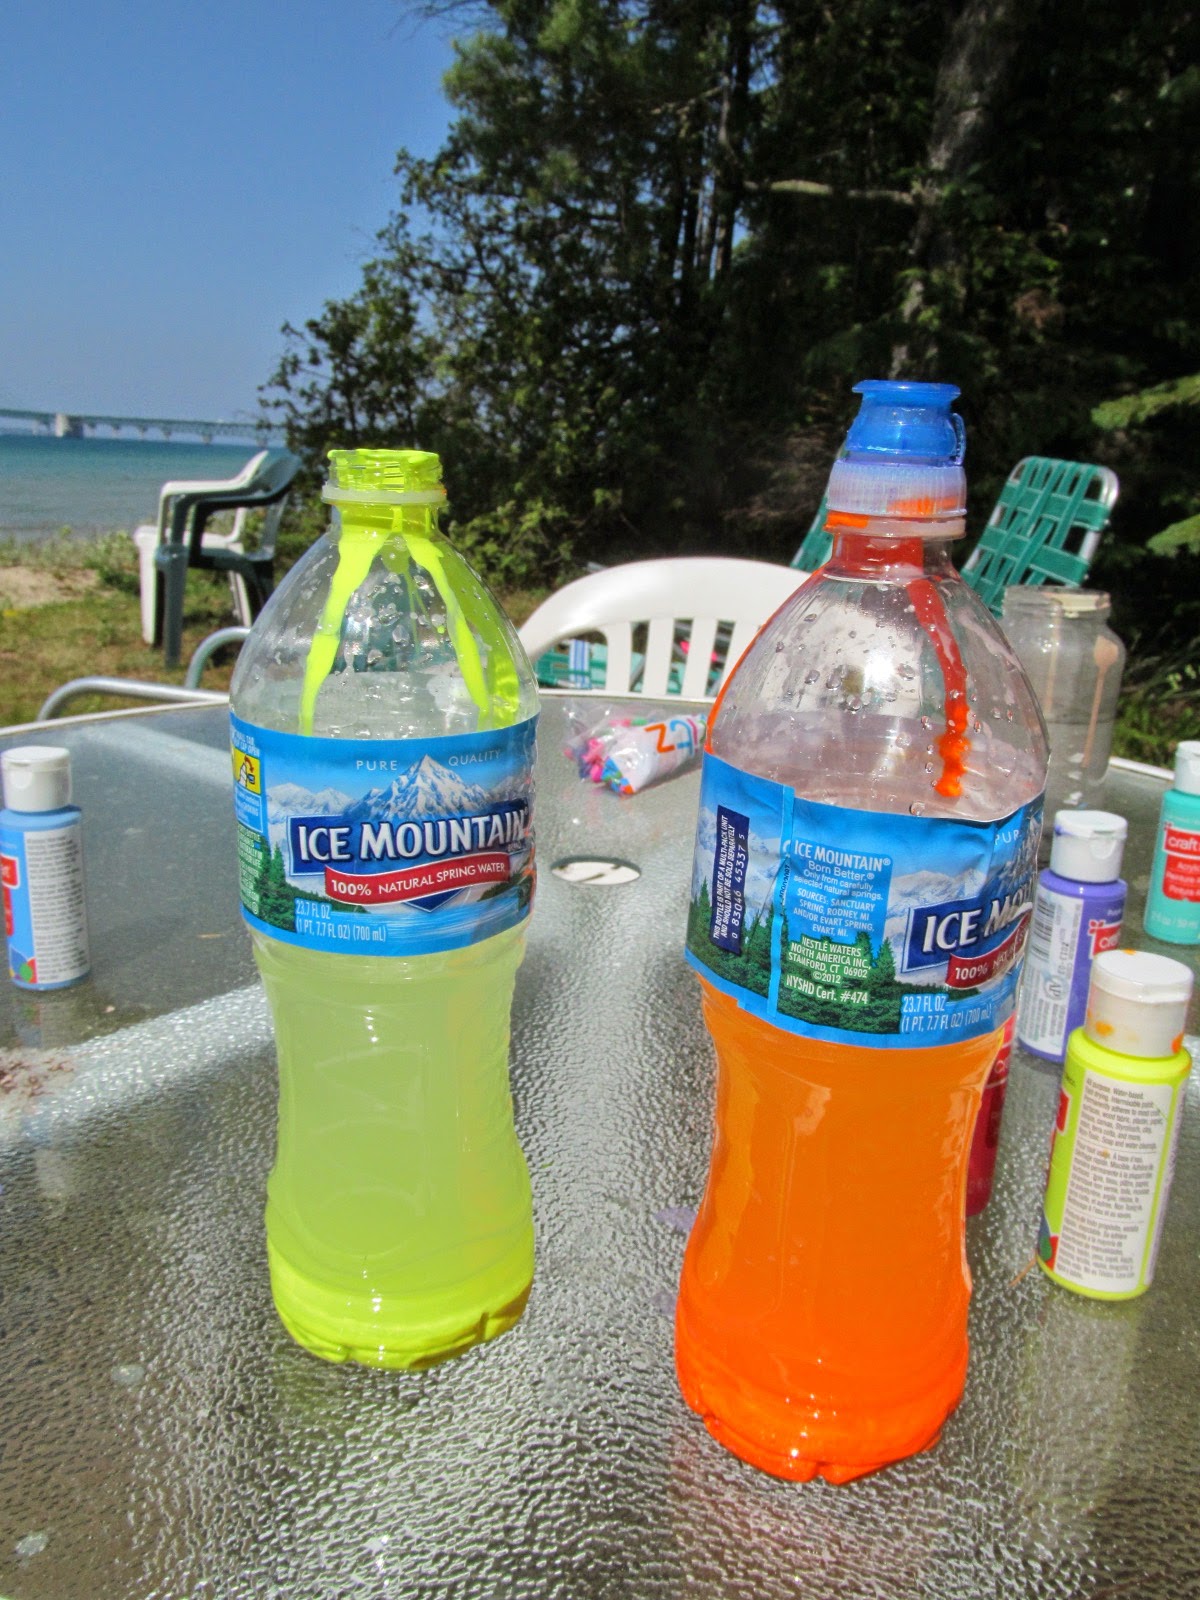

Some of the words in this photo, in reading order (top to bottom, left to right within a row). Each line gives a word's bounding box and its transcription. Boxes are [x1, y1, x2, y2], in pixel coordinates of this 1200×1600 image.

[356, 760, 398, 771] PURE
[448, 750, 501, 767] QUALITY
[721, 814, 729, 831] UNIT
[298, 825, 352, 861] ICE
[727, 824, 735, 862] SEPARATELY
[995, 829, 1021, 845] PUR
[719, 830, 728, 867] MULTI-PACK
[794, 840, 813, 859] ICE
[725, 861, 733, 879] SOLD
[734, 844, 746, 883] 45337
[808, 860, 832, 874] Born
[331, 879, 372, 896] 100%
[378, 876, 434, 895] NATURAL
[436, 865, 476, 883] SPRING
[477, 862, 506, 875] WATER
[717, 870, 725, 881] OF
[724, 877, 732, 888] BE
[803, 869, 821, 881] Only
[821, 874, 838, 885] from
[839, 879, 874, 891] carefully
[716, 880, 725, 897] PART
[723, 885, 731, 900] NOT
[793, 875, 823, 889] selected
[823, 884, 850, 896] natural
[851, 889, 884, 901] springs.
[295, 899, 310, 916] 23.7
[311, 903, 320, 918] FL
[320, 904, 331, 919] OZ
[731, 889, 743, 927] 83046
[797, 888, 829, 904] SOURCES:
[831, 898, 876, 912] SANCTUARY
[715, 902, 724, 926] BOTTLE
[722, 899, 732, 925] SHOULD
[793, 907, 819, 921] AND/OR
[820, 915, 843, 927] EVART
[860, 912, 870, 921] MI
[315, 921, 326, 937] 7.7
[327, 923, 337, 938] FL
[338, 924, 351, 940] OZ)
[353, 925, 370, 941] (700
[372, 925, 387, 942] mL)
[712, 925, 721, 939] THIS
[720, 924, 728, 939] AND
[922, 909, 982, 953] ICE
[791, 942, 815, 958] NORTH
[816, 953, 851, 966] AMERICA
[801, 936, 828, 952] NESTLÉ
[829, 943, 862, 957] WATERS
[829, 964, 840, 974] CT
[843, 966, 868, 978] 06902
[955, 964, 988, 980] 100%
[786, 974, 815, 995] NYSHD
[816, 985, 837, 1001] Cert.
[840, 990, 869, 1005] #474
[903, 995, 922, 1013] 23.7
[923, 995, 933, 1012] FL
[934, 995, 948, 1012] OZ
[926, 1015, 940, 1031] 7.7
[940, 1014, 949, 1030] FL
[950, 1011, 964, 1028] OZ)
